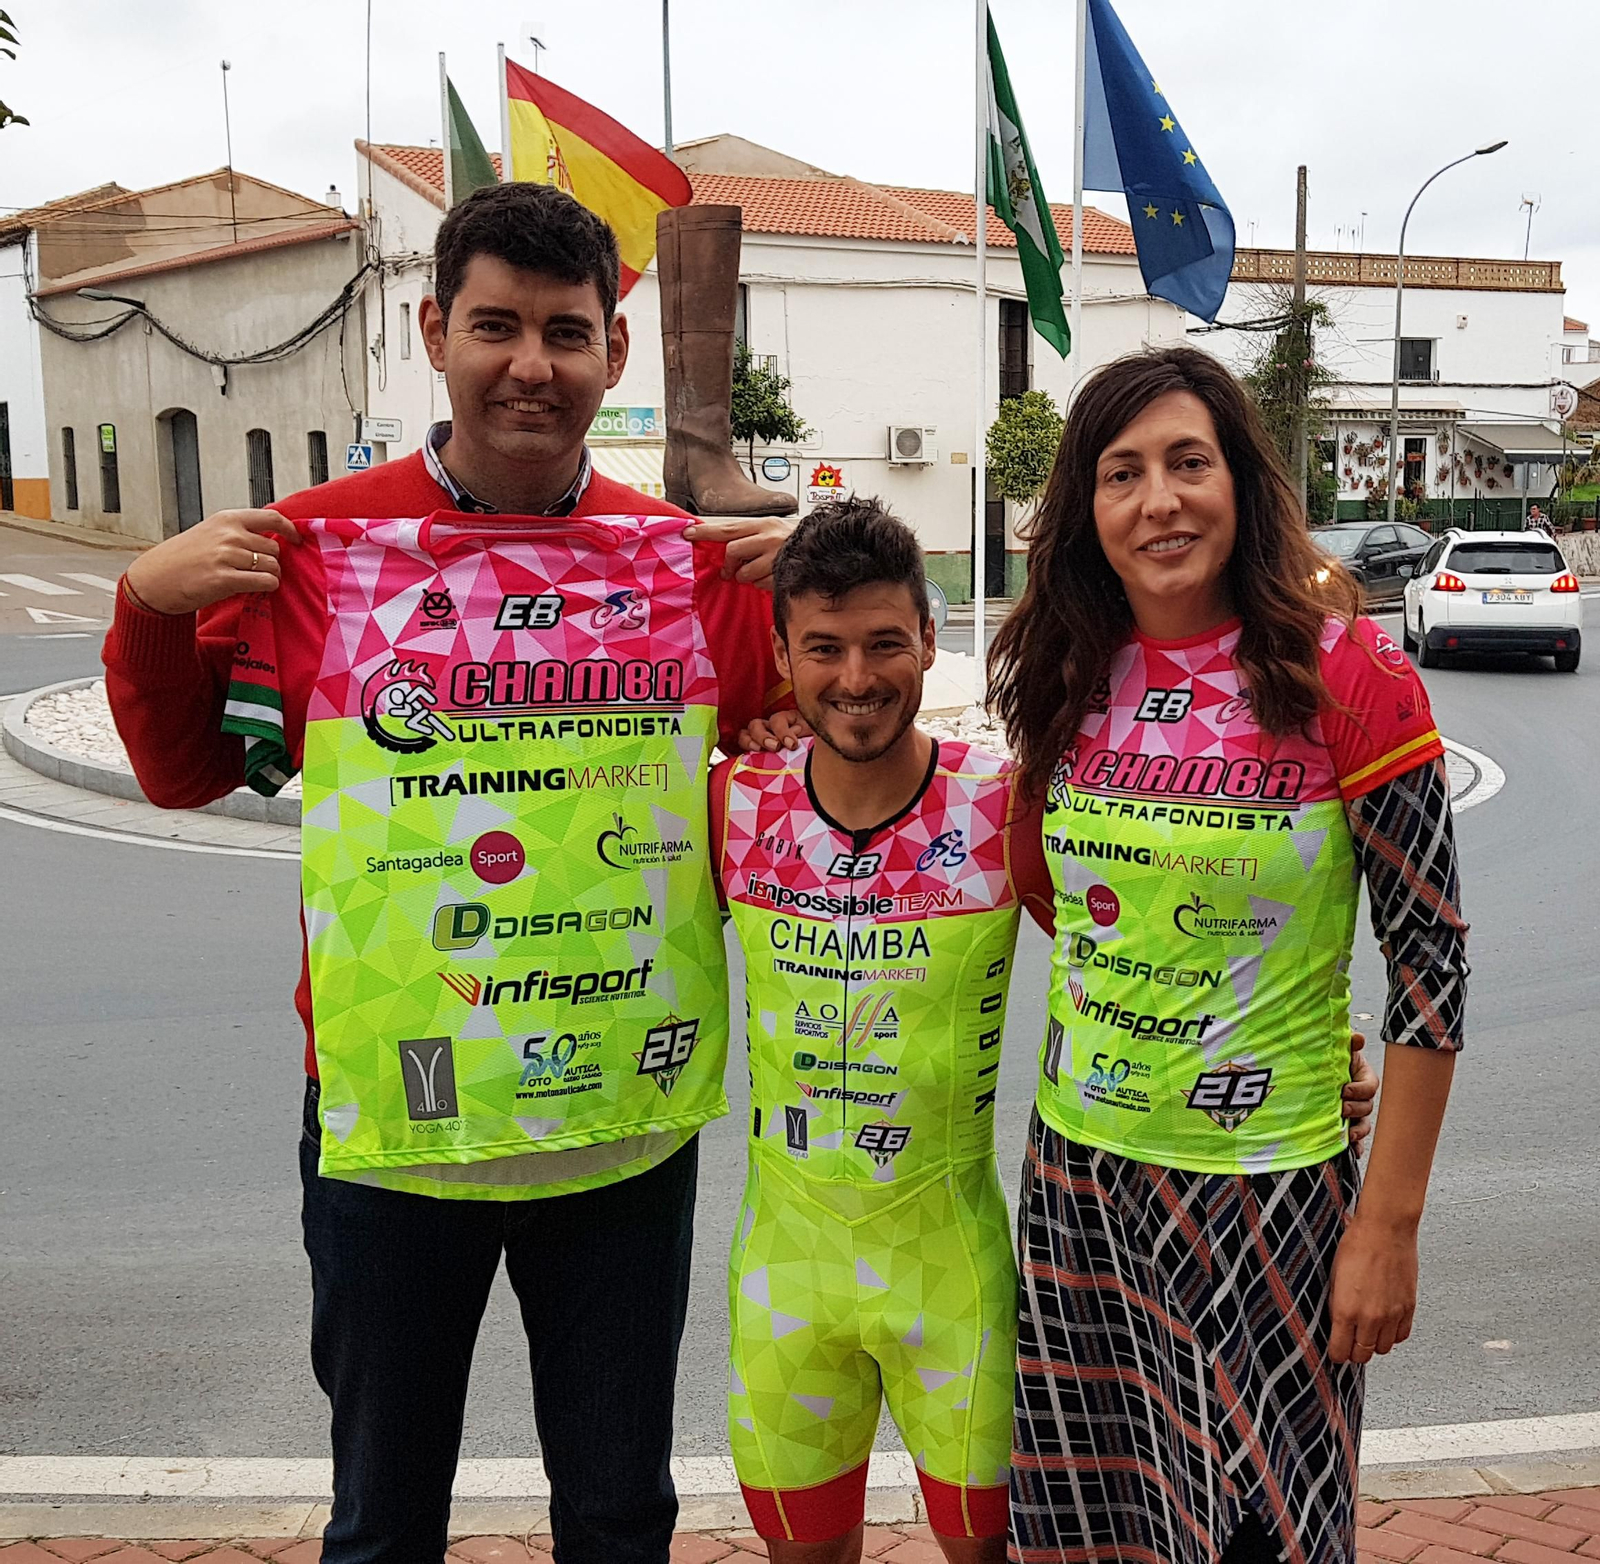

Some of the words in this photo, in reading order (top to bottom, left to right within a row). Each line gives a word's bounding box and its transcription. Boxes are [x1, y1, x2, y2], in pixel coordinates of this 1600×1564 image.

[451, 659, 683, 707] CHAMBA
[458, 718, 682, 742] ULTRAFONDISTA
[1080, 751, 1304, 799] CHAMBA
[1073, 797, 1294, 831] ULTRAFONDISTA
[366, 851, 463, 873] Santagadea
[478, 850, 518, 867] Sport
[619, 840, 693, 856] NUTRIFARMA
[1091, 897, 1115, 912] Sport
[494, 905, 652, 939] DISAGON
[1194, 917, 1277, 930] NUTRIFARMA
[771, 919, 930, 961] CHAMBA
[482, 959, 653, 1005] infisport
[1093, 952, 1222, 988] DISAGON
[579, 993, 609, 1005] SCIENCE
[1080, 992, 1216, 1038] infisport
[639, 1021, 698, 1072] 26
[873, 1031, 898, 1040] sport
[818, 1060, 897, 1075] DISAGON
[811, 1086, 898, 1105] infisport
[1189, 1070, 1269, 1108] 26
[857, 1127, 909, 1150] 26
